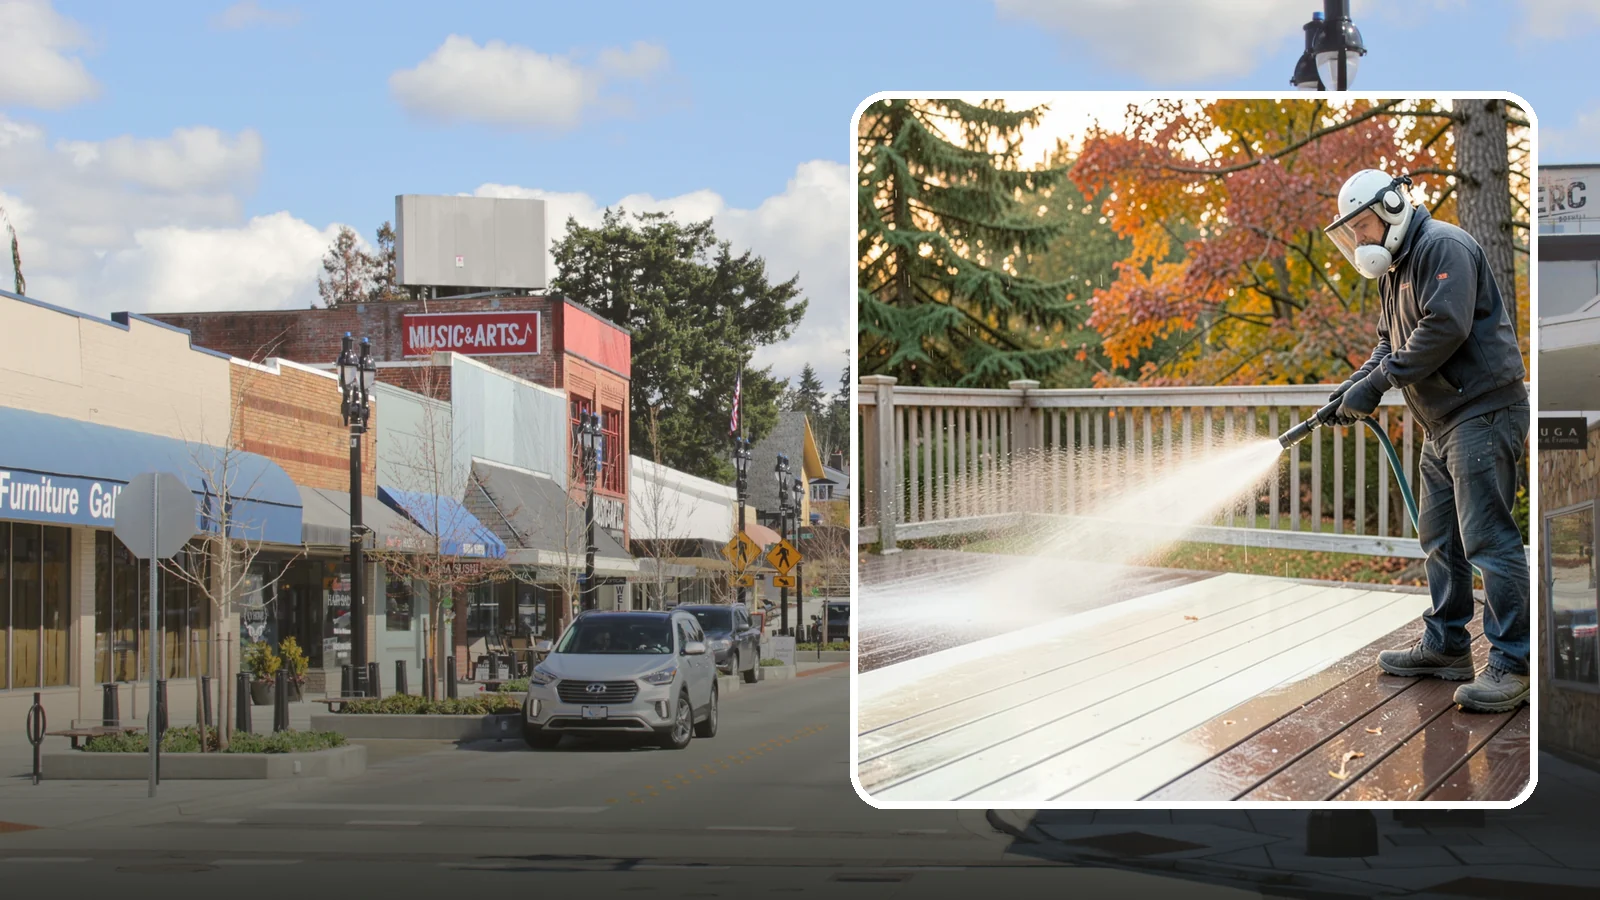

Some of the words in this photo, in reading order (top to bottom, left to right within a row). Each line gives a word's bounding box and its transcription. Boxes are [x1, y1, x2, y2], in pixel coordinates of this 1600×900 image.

[409, 323, 519, 349] MUSIC&ARTS
[0, 471, 79, 515] Furniture
[89, 482, 121, 519] Gal
[453, 563, 479, 574] SUSHI
